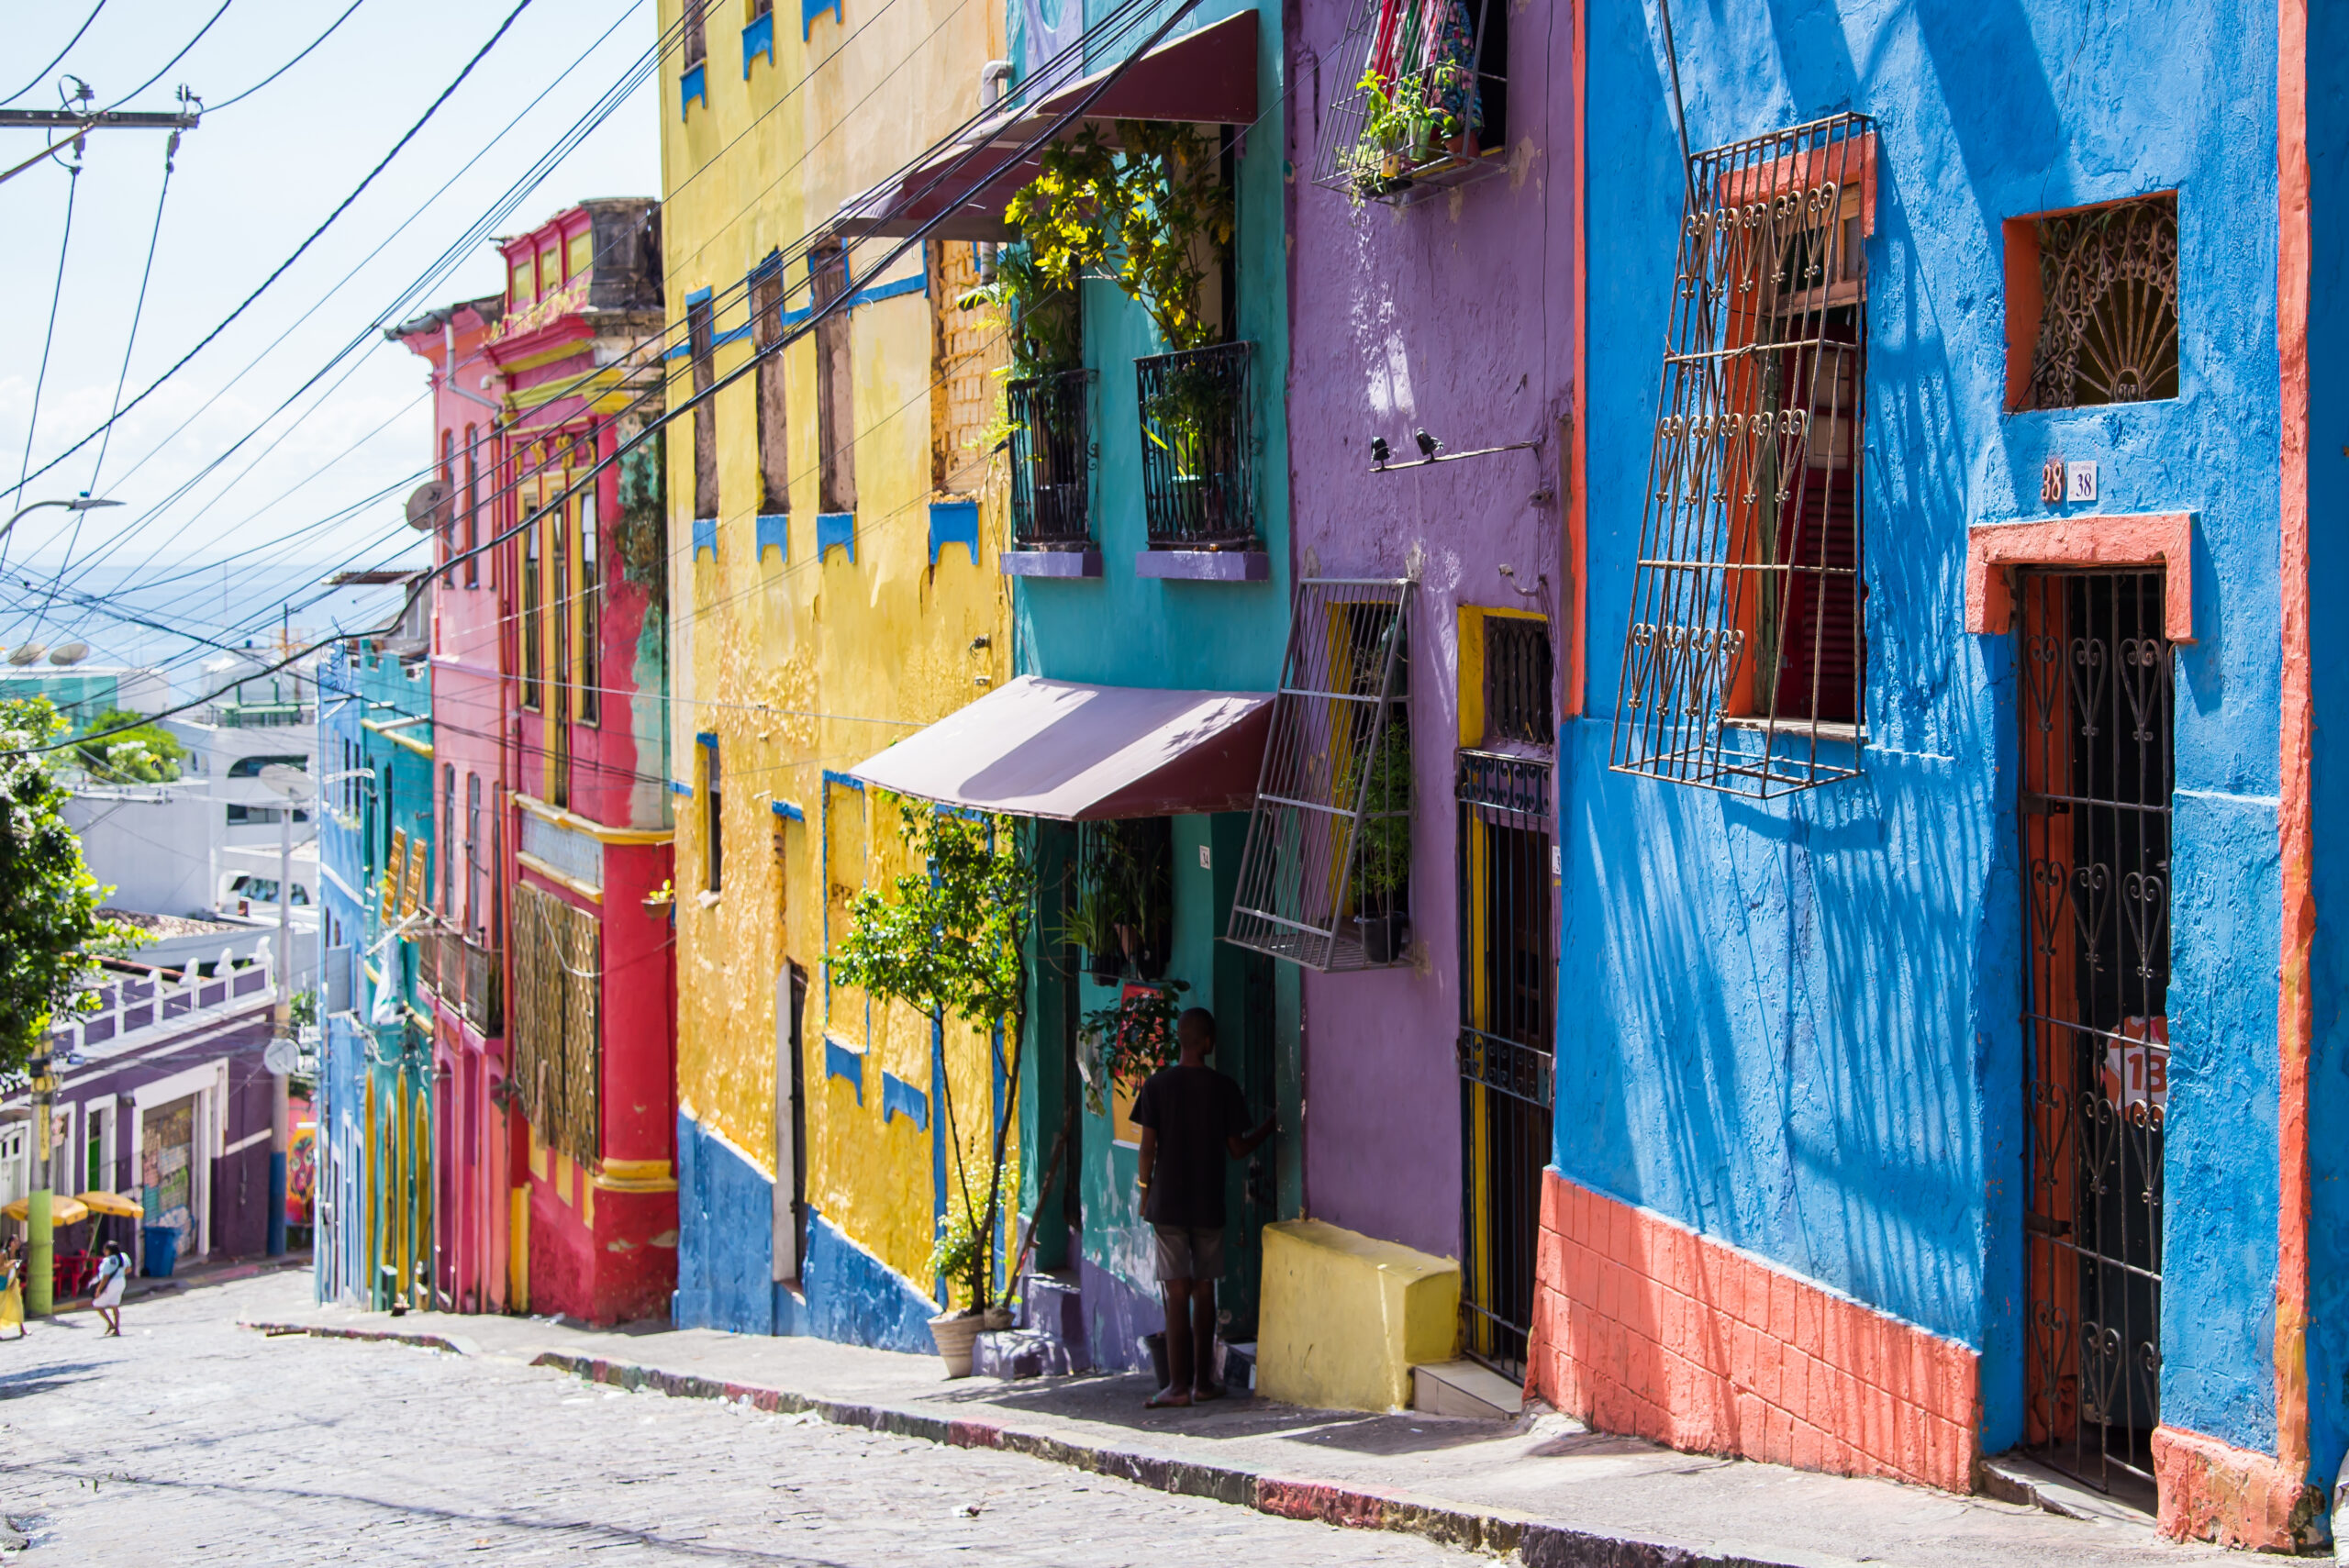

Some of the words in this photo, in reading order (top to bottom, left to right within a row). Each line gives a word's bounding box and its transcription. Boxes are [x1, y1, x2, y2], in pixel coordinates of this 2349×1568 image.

[2042, 463, 2062, 501] 38
[2076, 473, 2092, 496] 38
[2127, 1053, 2167, 1093] 13
